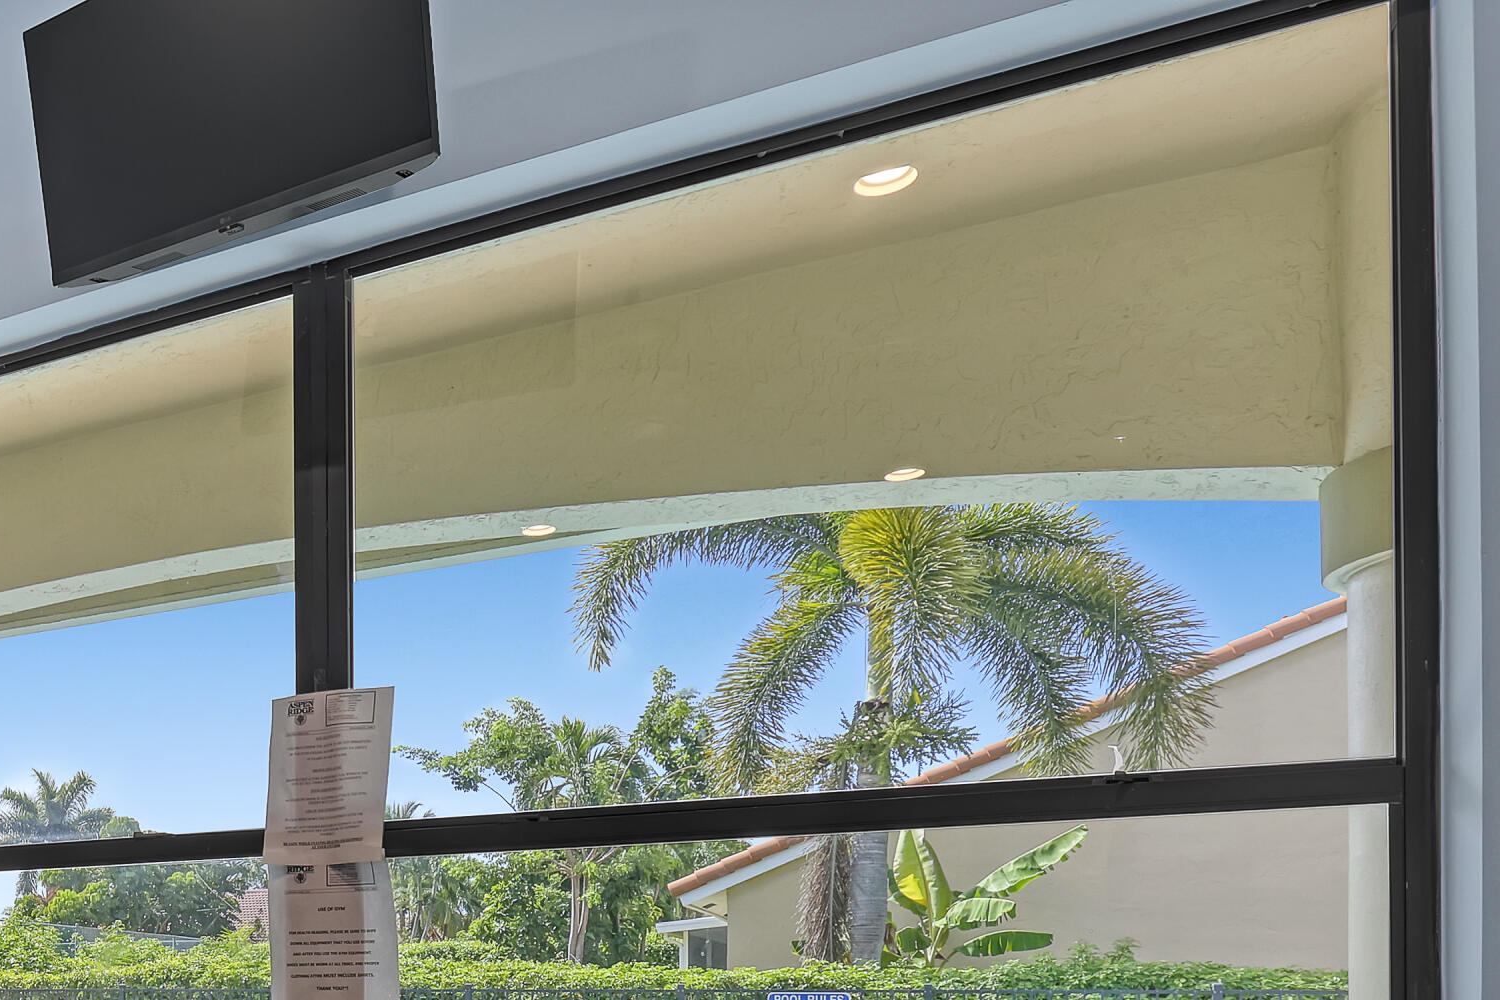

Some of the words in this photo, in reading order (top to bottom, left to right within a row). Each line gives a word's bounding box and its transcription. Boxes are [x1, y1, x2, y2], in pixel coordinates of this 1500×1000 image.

[288, 700, 314, 708] ASPEN
[288, 706, 315, 716] RIDGE
[287, 865, 314, 873] RIDGE
